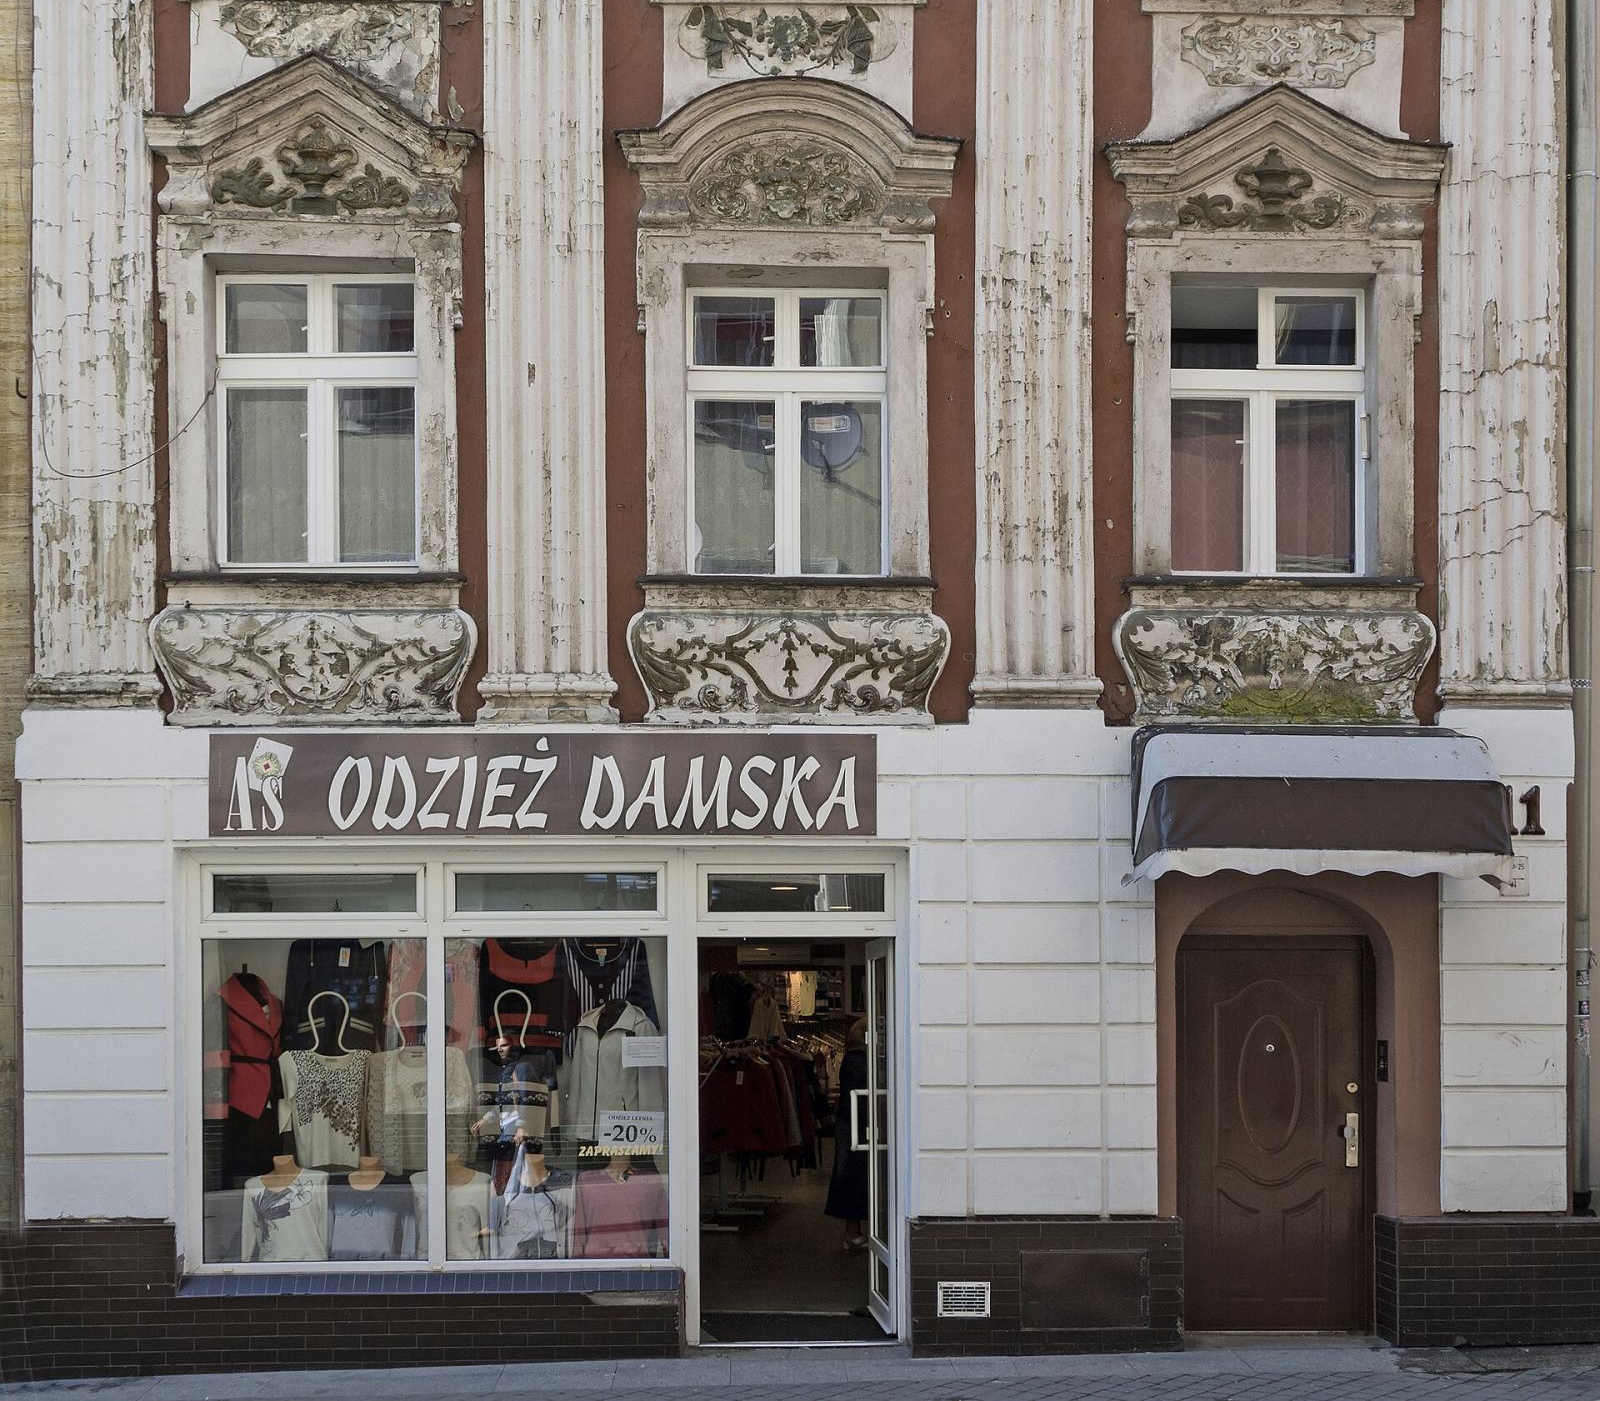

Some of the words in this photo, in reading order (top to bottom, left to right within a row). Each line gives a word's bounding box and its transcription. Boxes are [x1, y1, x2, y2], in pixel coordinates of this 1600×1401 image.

[328, 736, 558, 831] ODZIEŻ
[580, 755, 859, 830] DAMSKA
[603, 1124, 657, 1143] -20%
[578, 1144, 664, 1157] ZAPRASZAMY!
